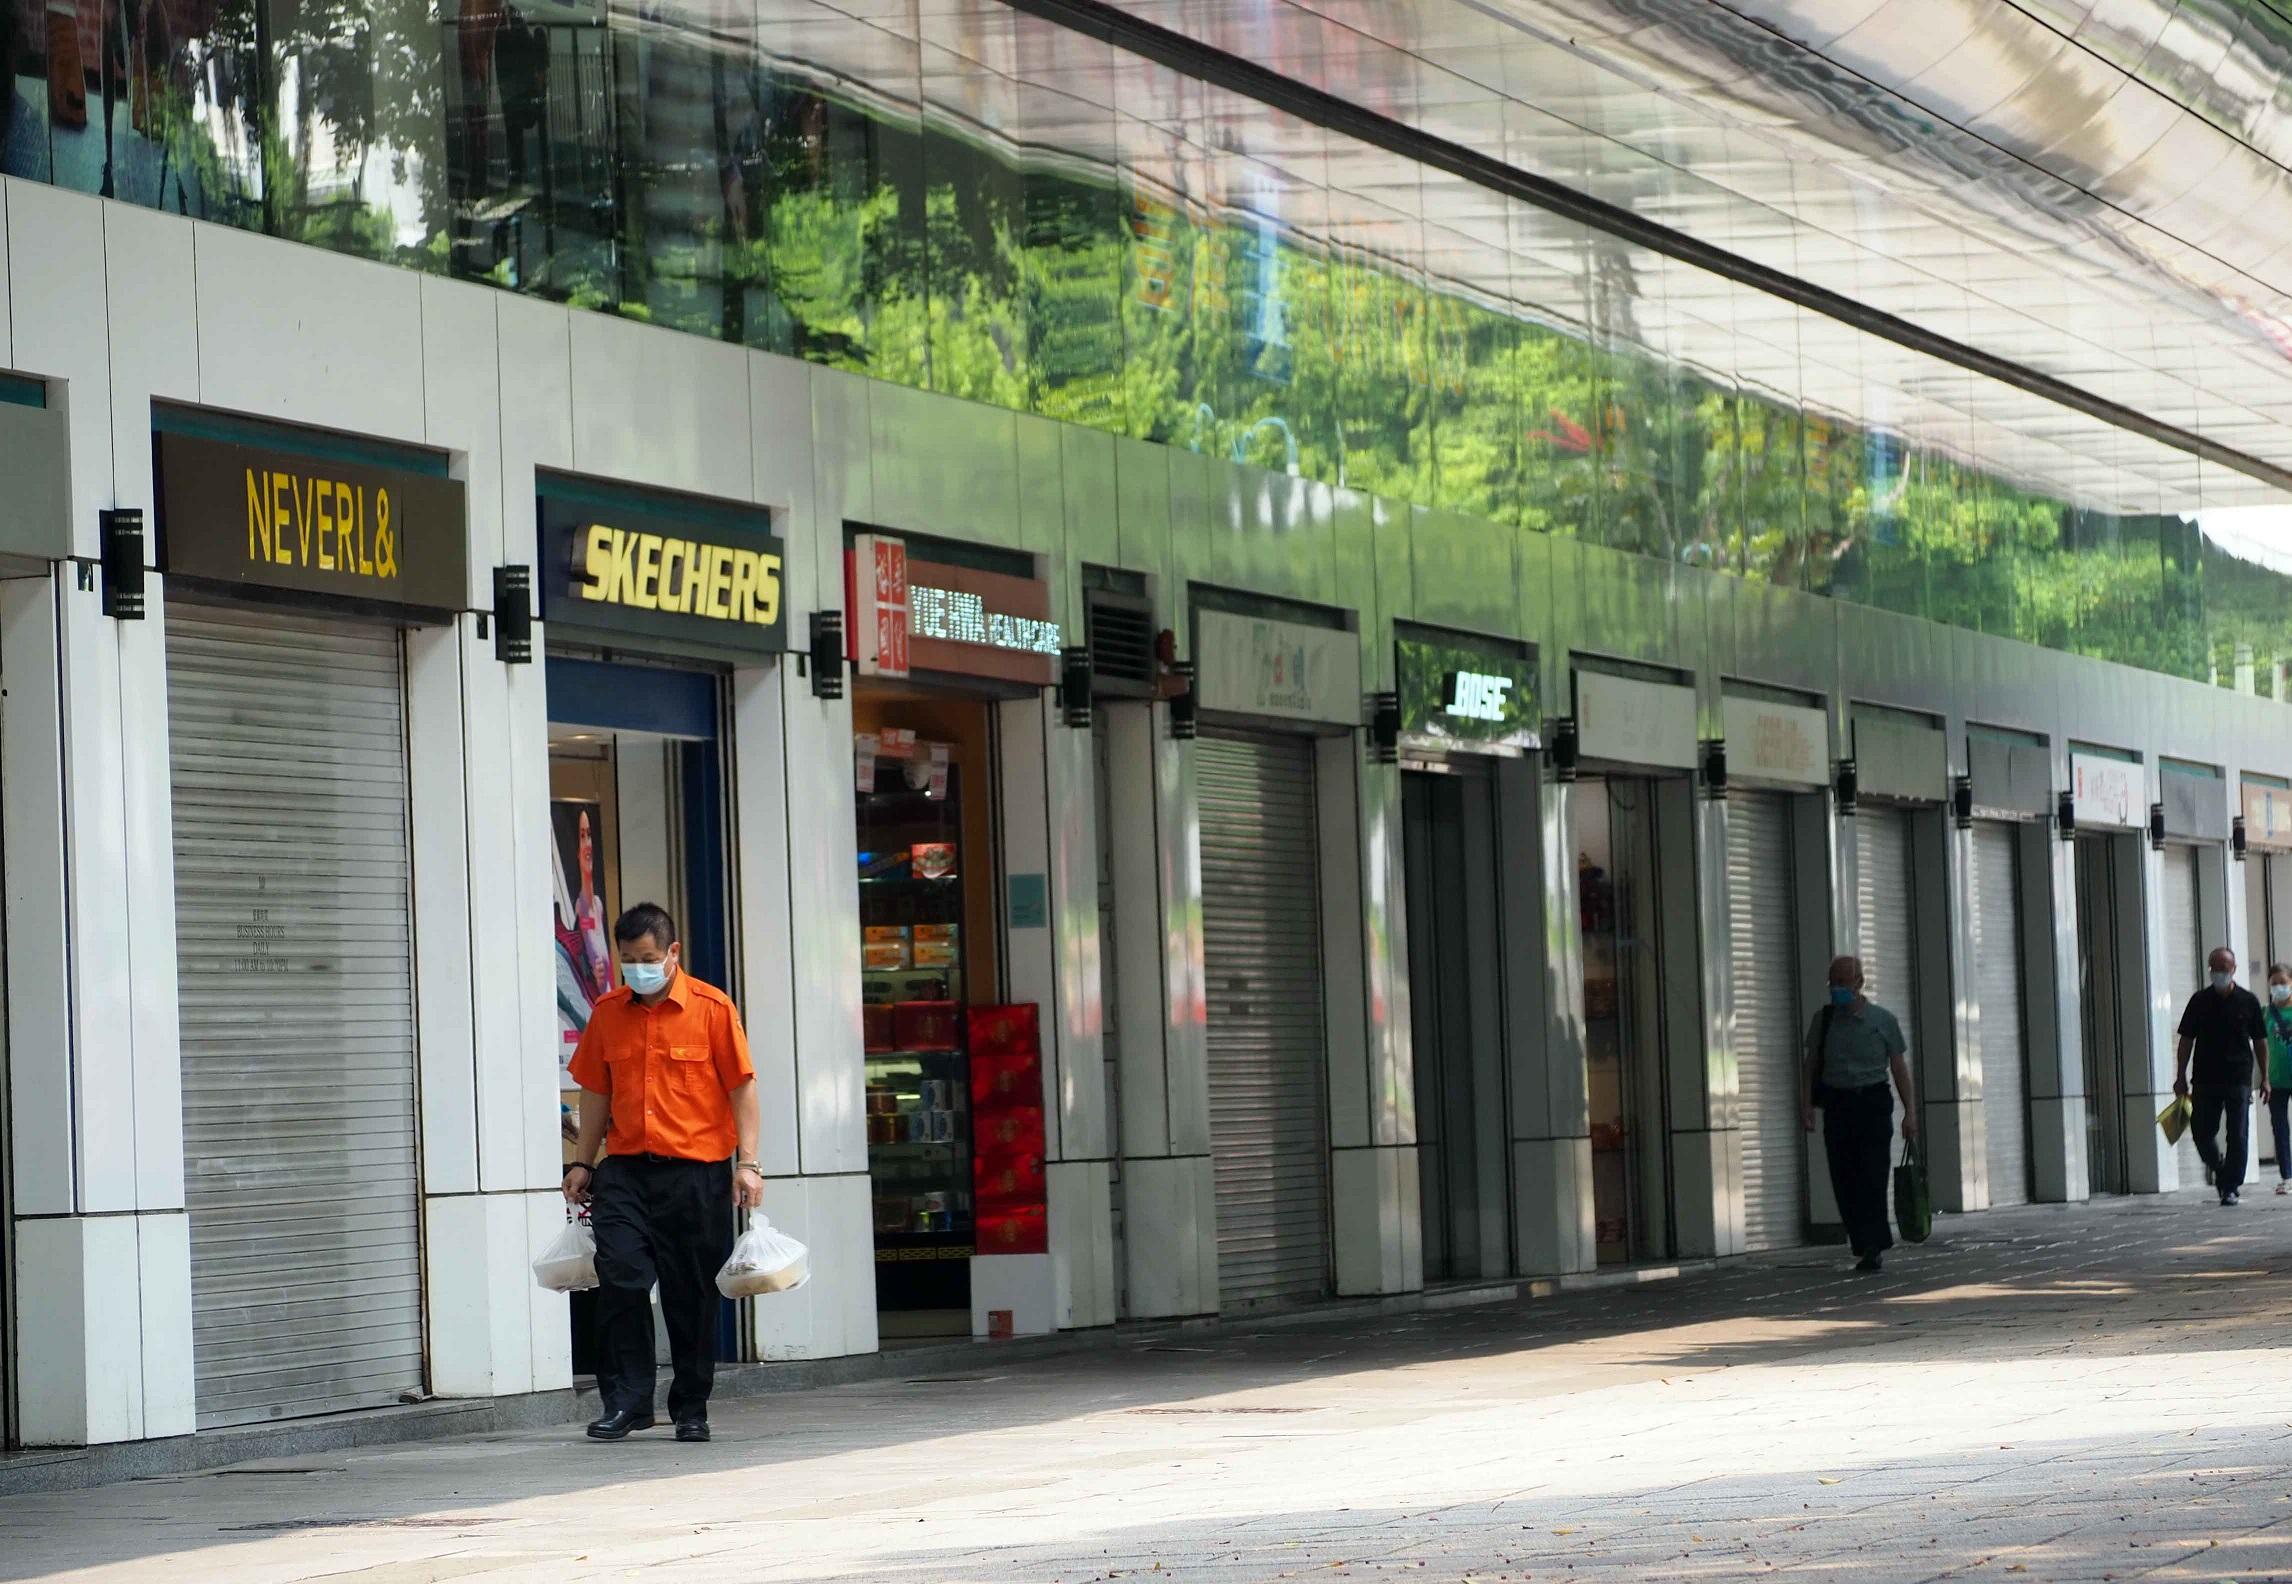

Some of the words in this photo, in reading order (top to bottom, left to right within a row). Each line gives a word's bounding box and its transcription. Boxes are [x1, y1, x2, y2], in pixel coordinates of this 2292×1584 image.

[246, 468, 398, 579] NEVERL&
[581, 524, 782, 625] SKECHERS
[910, 584, 947, 638] YUE
[987, 613, 1062, 656] HEALTHCARE
[1445, 670, 1513, 721] BOSE
[252, 941, 270, 955] DAILY
